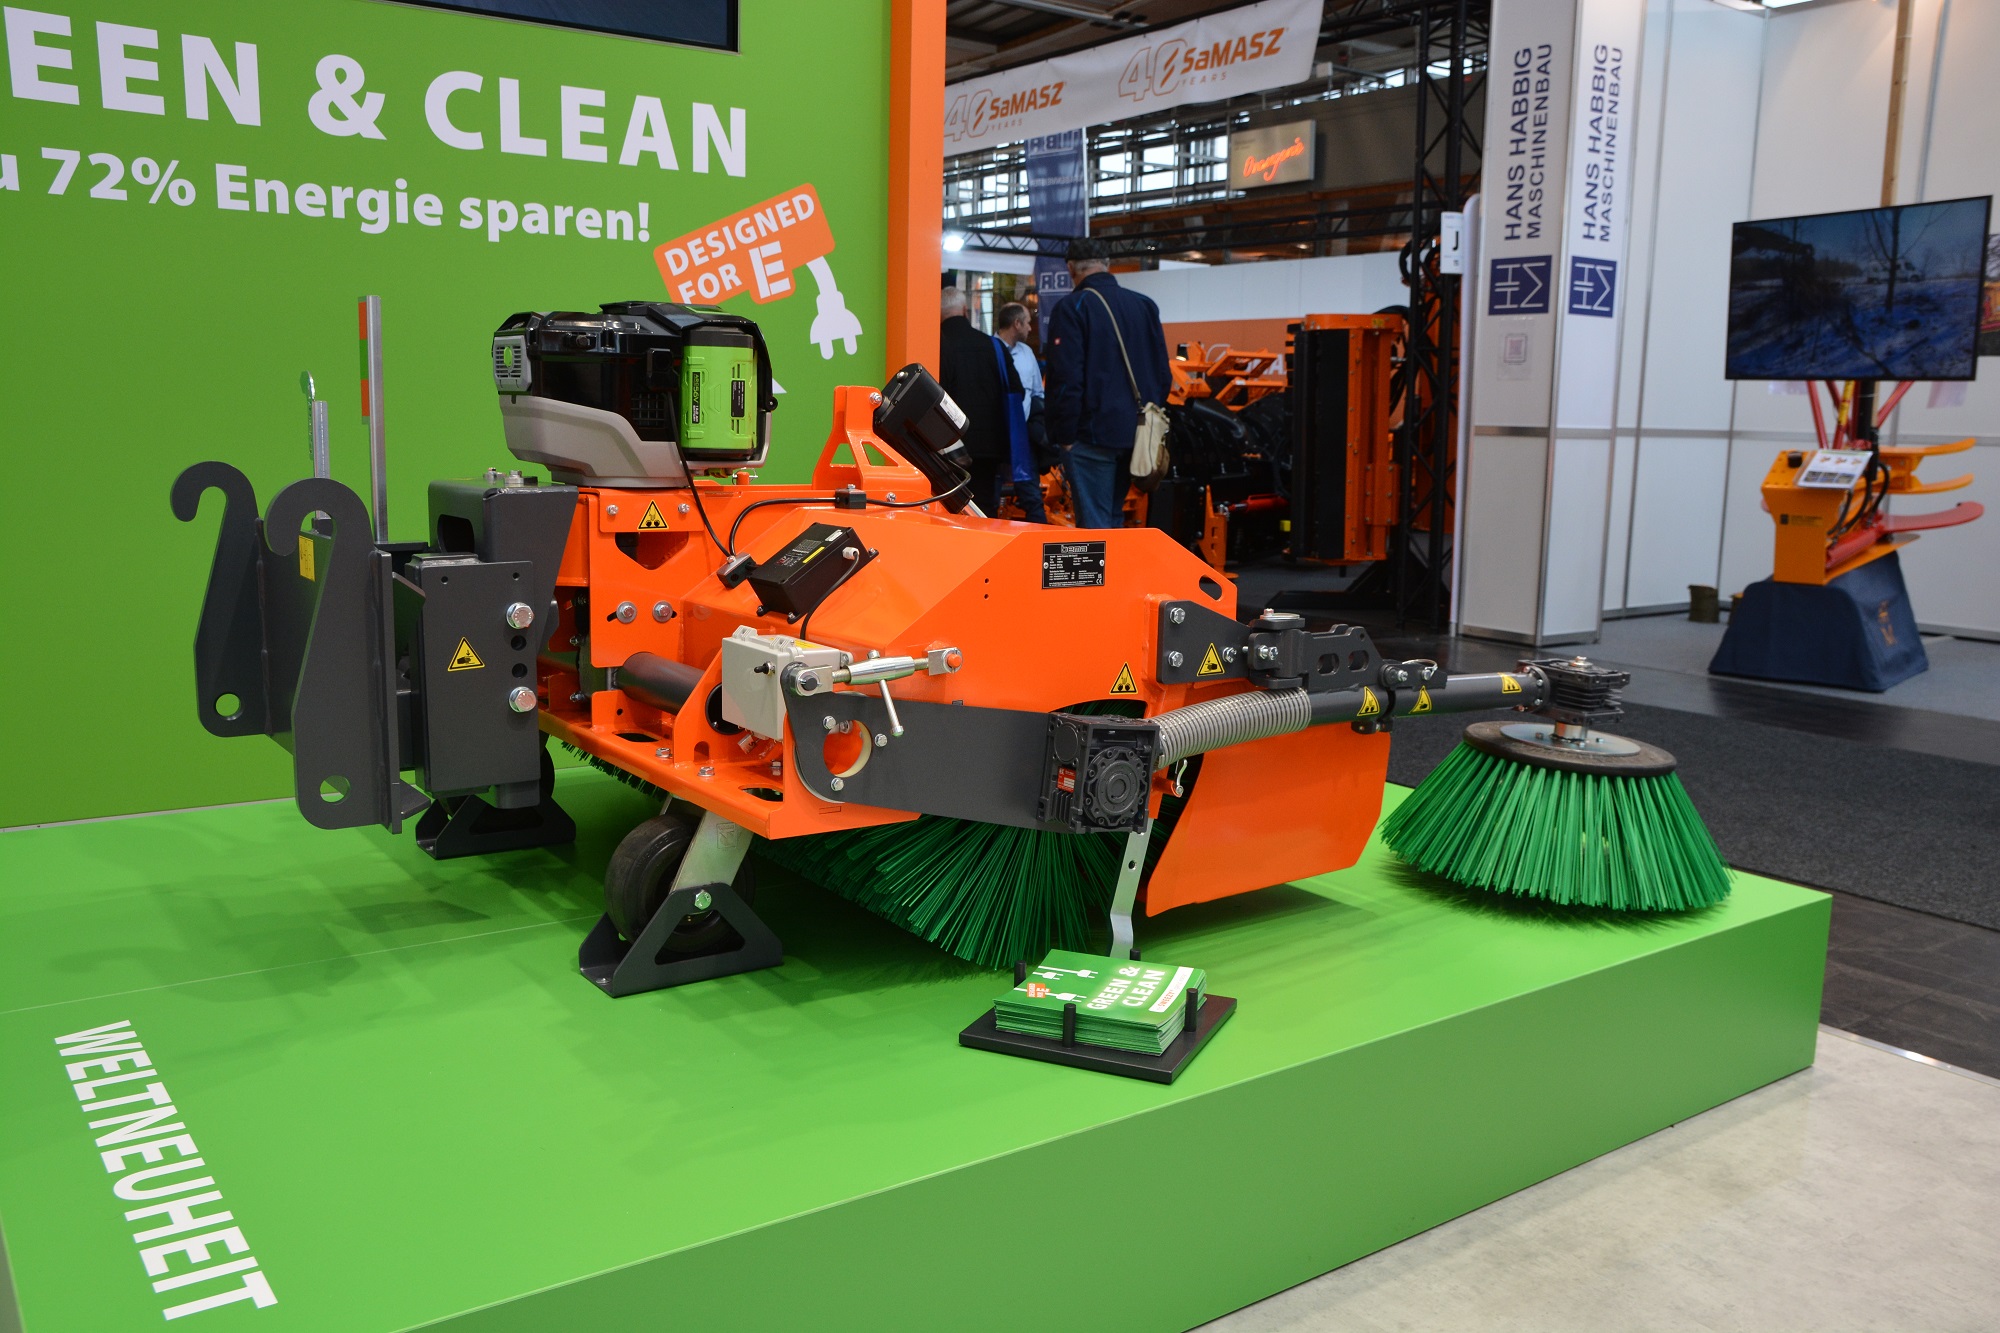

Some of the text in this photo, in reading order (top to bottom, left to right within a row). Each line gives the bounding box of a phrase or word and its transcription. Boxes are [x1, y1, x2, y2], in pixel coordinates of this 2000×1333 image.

[1181, 27, 1285, 74] SaMASZ
[1182, 71, 1227, 86] YEARS
[307, 54, 388, 140] &
[424, 70, 747, 178] CLEAN
[988, 81, 1065, 121] SaMASZ
[1504, 48, 1532, 241] HANS HABBIG
[1526, 44, 1552, 239] MASCHINENBAU
[1582, 44, 1608, 241] HANS HABBIG
[1599, 48, 1623, 242] MASCHINENBAU
[41, 147, 196, 206] 72%
[215, 163, 443, 235] Energie
[459, 197, 651, 242] sparen!
[664, 194, 815, 276] DESIGNED
[677, 241, 791, 304] FOR E
[1087, 966, 1140, 1010] GREEN &
[1122, 969, 1166, 1007] CLEAN
[54, 1019, 278, 1321] WELTNEUHEIT
